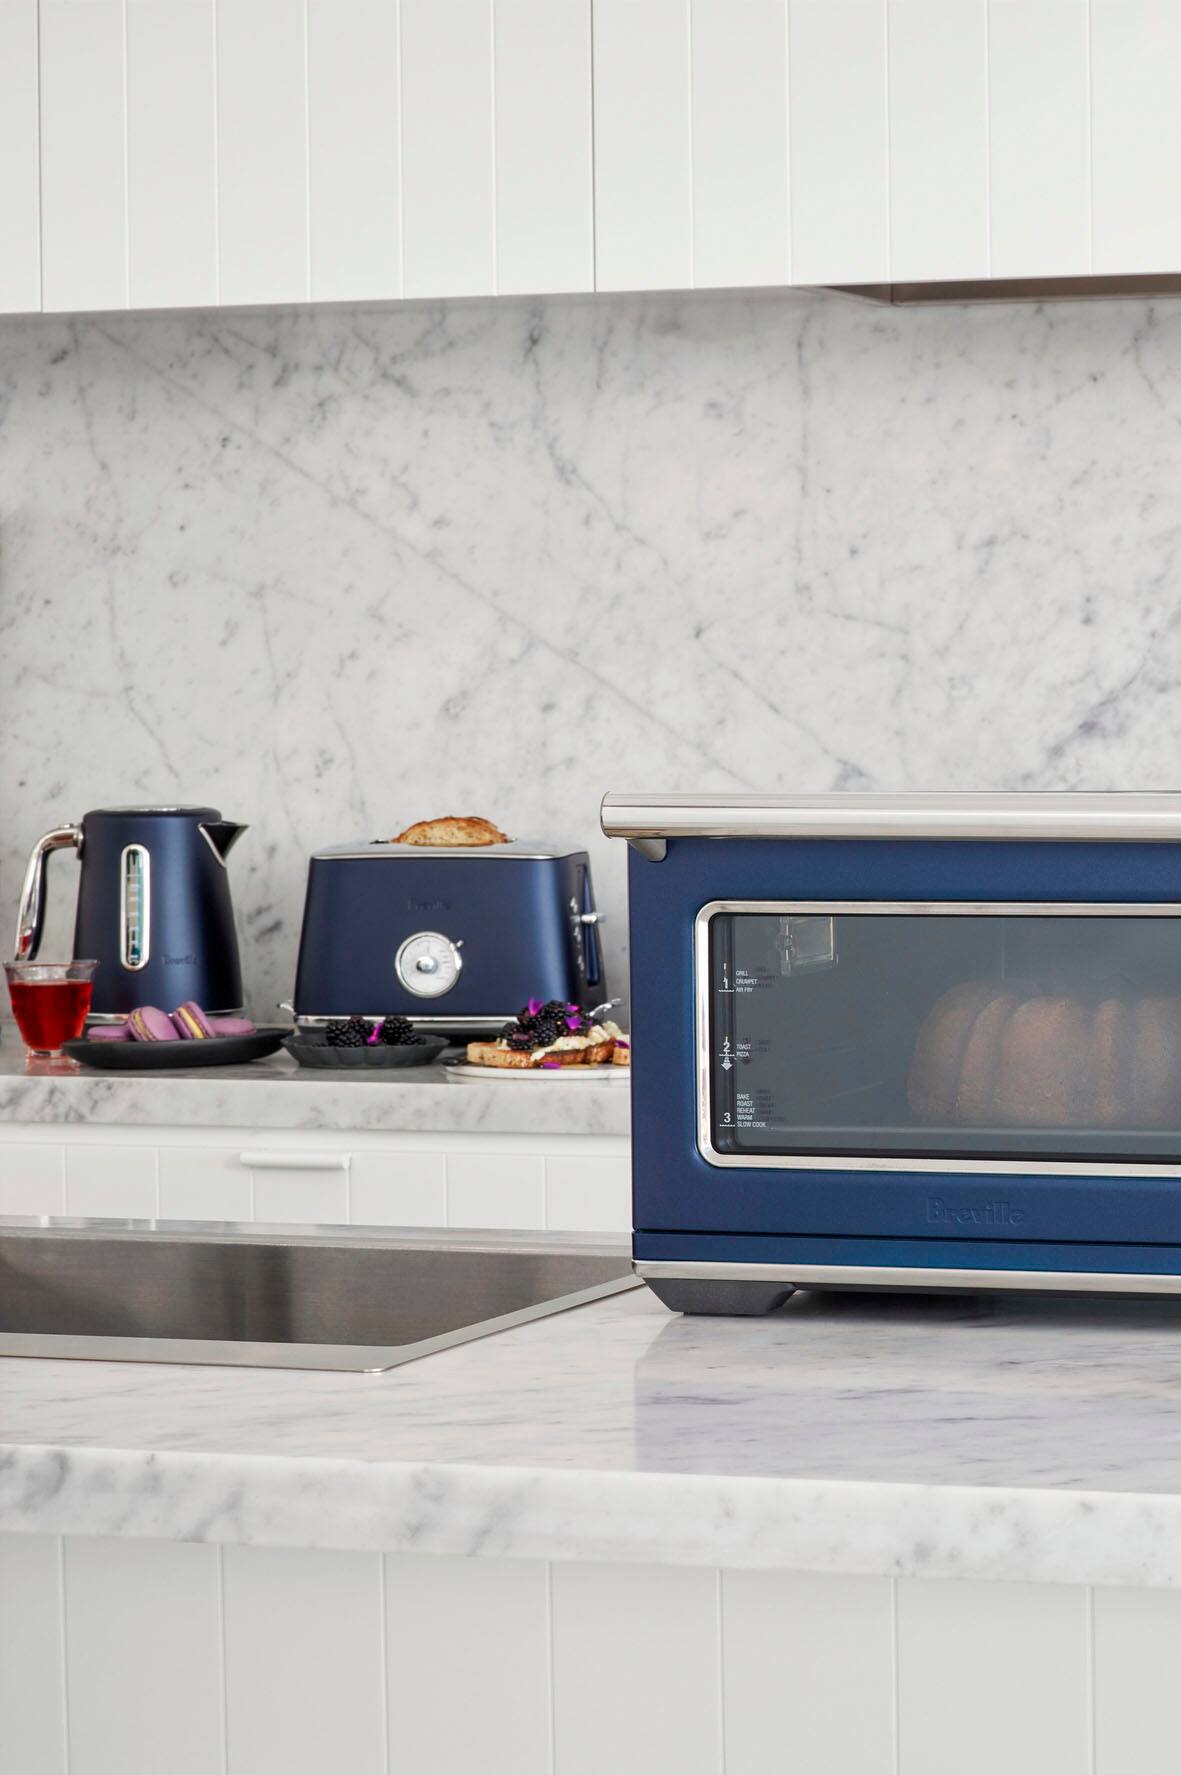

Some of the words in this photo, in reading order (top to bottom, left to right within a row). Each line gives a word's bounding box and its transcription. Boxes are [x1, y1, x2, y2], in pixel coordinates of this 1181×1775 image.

[723, 1112, 731, 1123] 3
[736, 1120, 751, 1128] SLOW
[926, 1196, 1025, 1225] Breville
